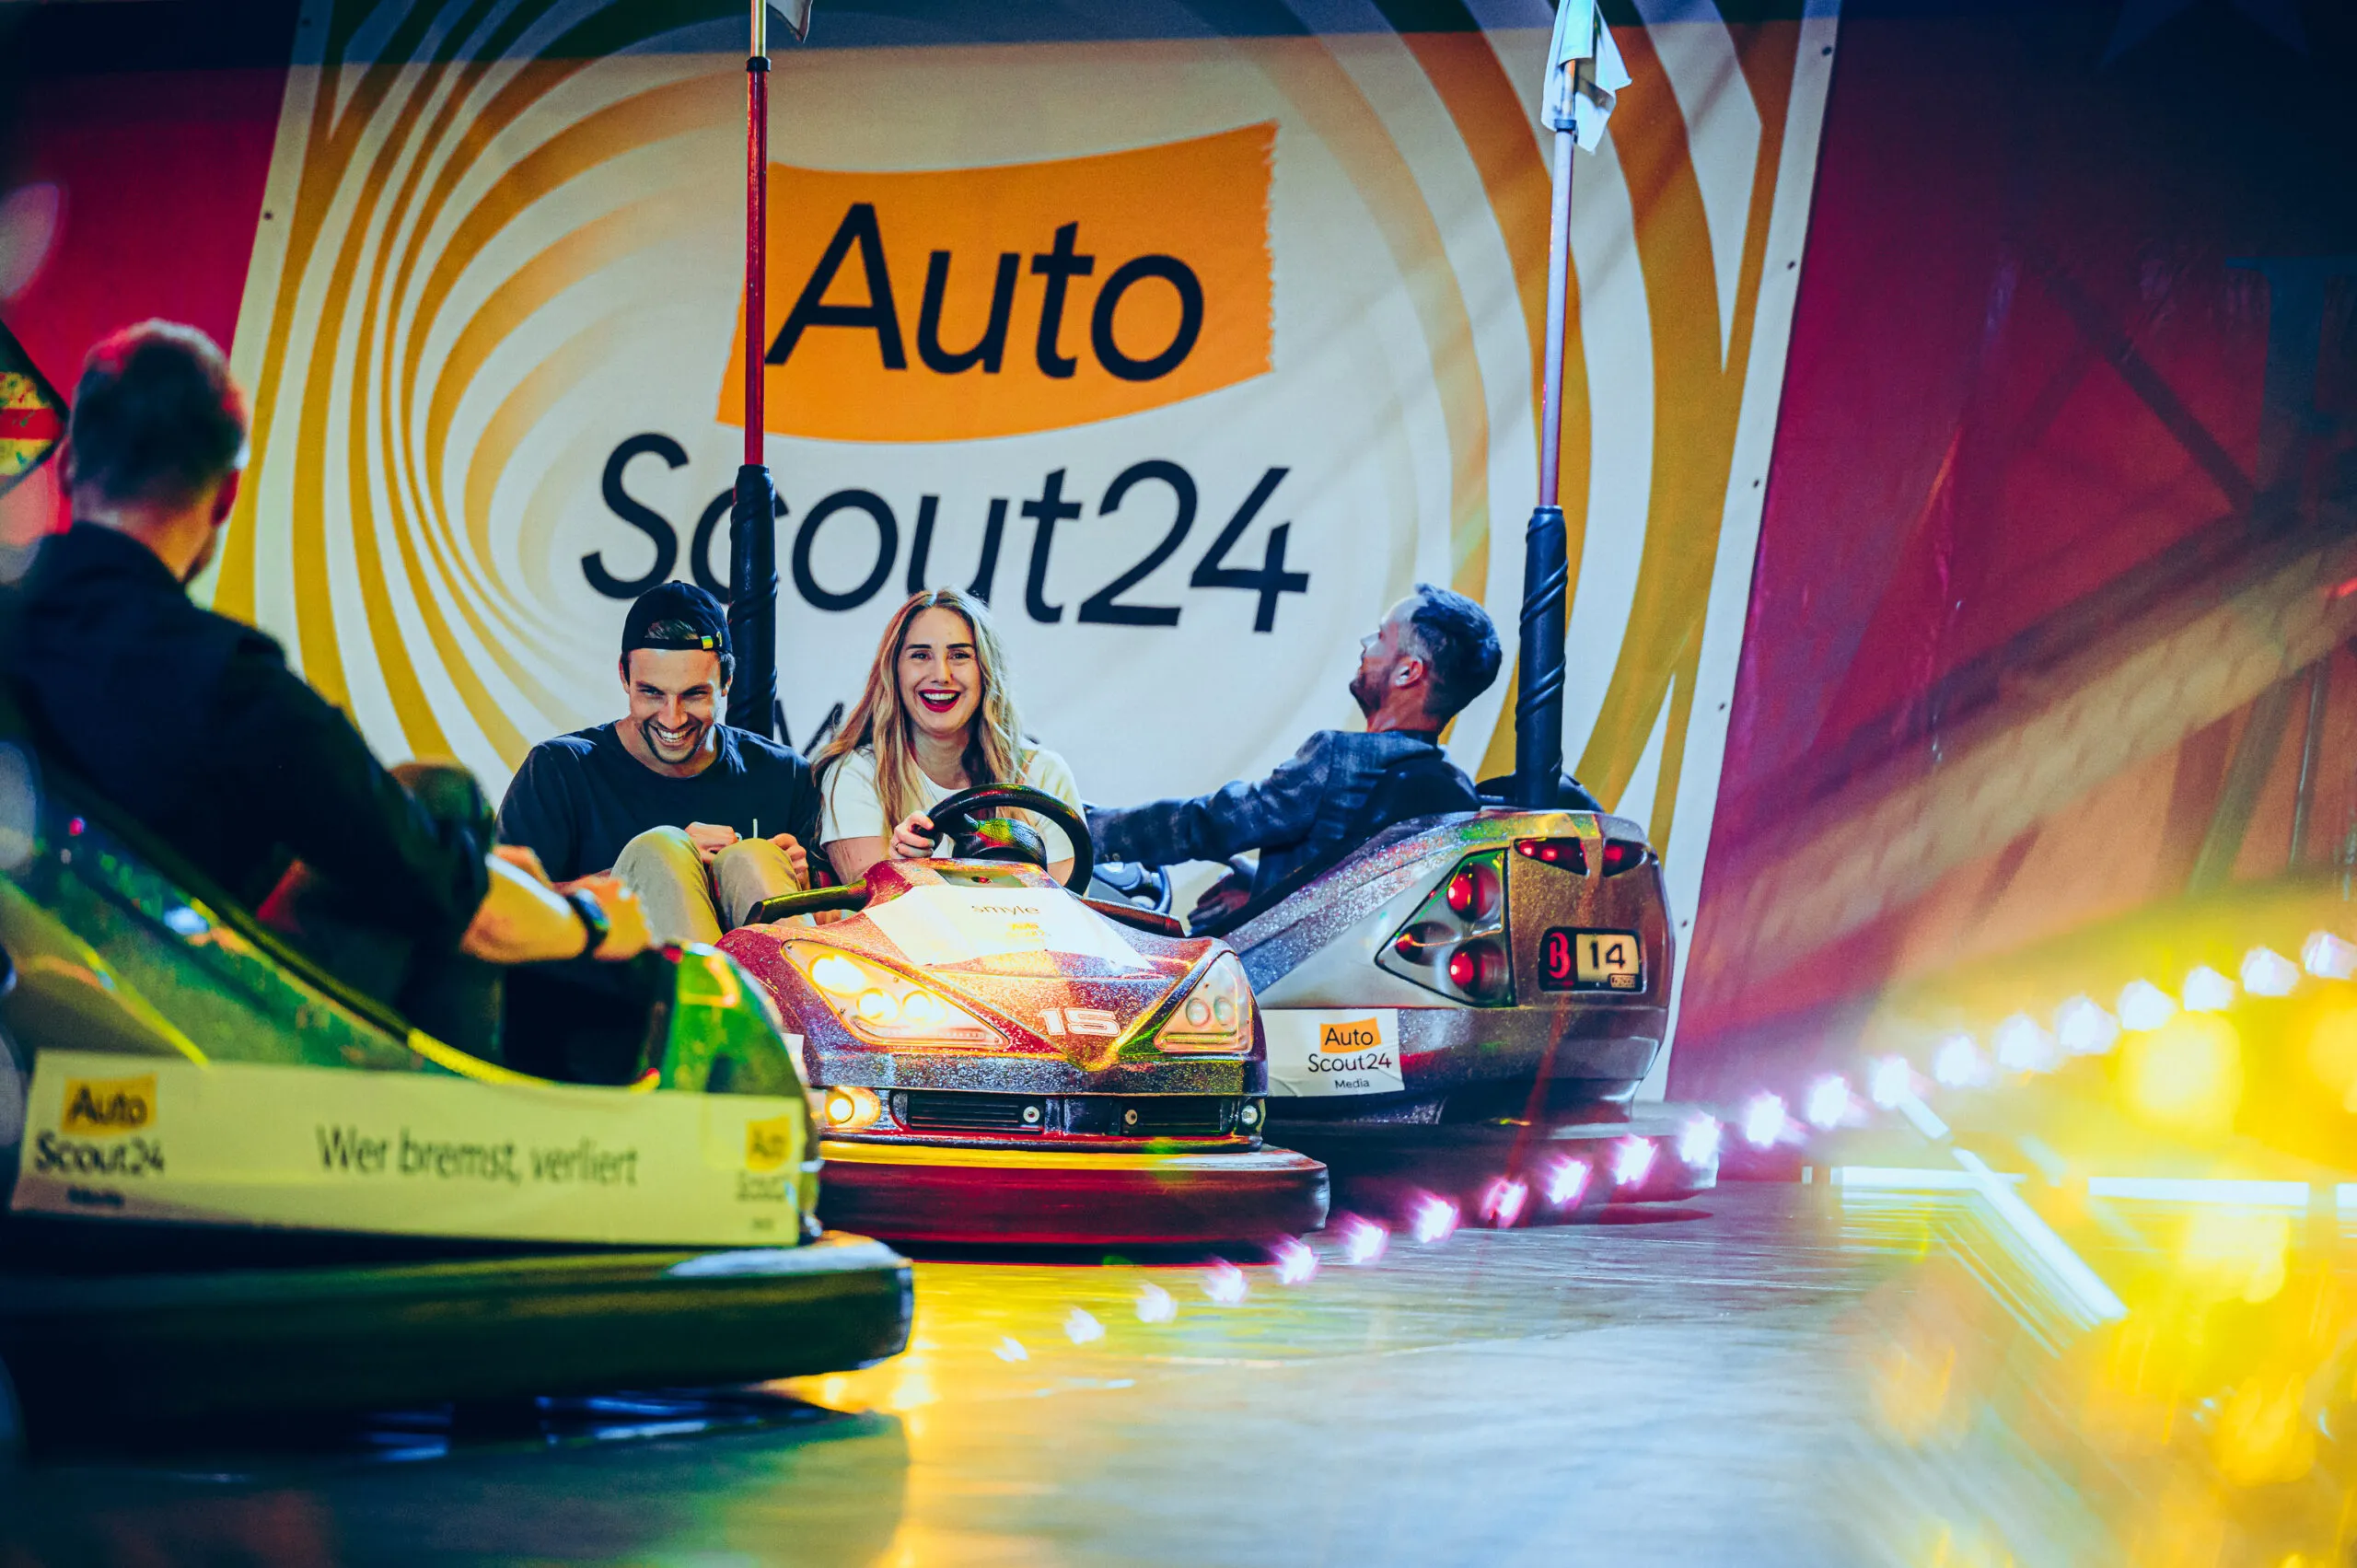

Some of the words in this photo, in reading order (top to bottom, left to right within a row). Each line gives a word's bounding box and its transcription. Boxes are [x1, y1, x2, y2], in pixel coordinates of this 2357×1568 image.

[764, 203, 1205, 382] Auto
[581, 432, 1310, 633] Scout24
[971, 904, 1040, 915] smyle
[1590, 940, 1626, 970] 14
[1038, 1007, 1121, 1038] 15
[1324, 1027, 1374, 1046] Auto
[1307, 1052, 1392, 1073] Scout24
[1334, 1078, 1370, 1088] Media
[66, 1085, 148, 1127] Auto
[316, 1122, 388, 1174] Wer
[397, 1124, 522, 1186] bremst,
[529, 1135, 639, 1187] verliert
